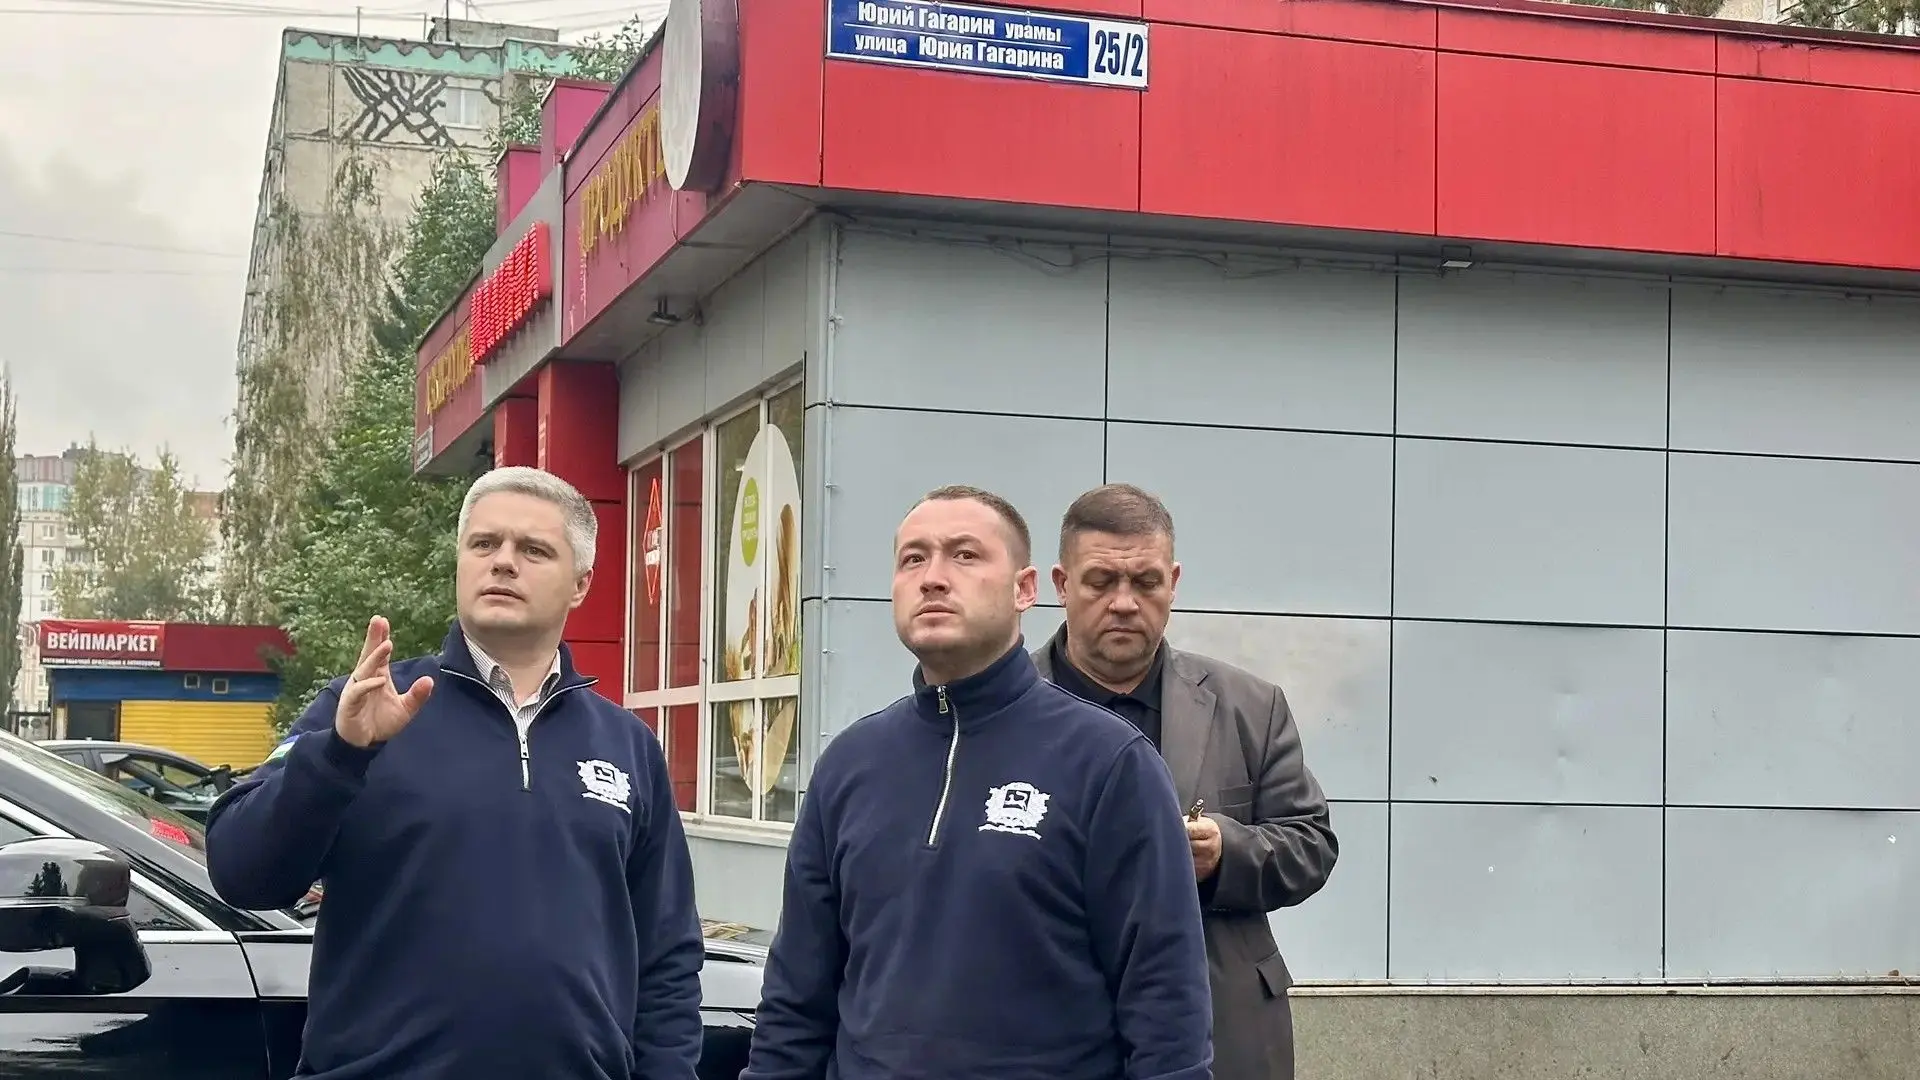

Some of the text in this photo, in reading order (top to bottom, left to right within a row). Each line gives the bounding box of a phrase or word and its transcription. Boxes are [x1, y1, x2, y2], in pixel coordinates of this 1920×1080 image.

[858, 1, 1062, 42] Юрий Гагарин урамы
[855, 34, 1064, 70] улица Юрия Гагарина
[1094, 30, 1144, 77] 25/2
[47, 629, 158, 652] ВЕЙПМАРКЕТ
